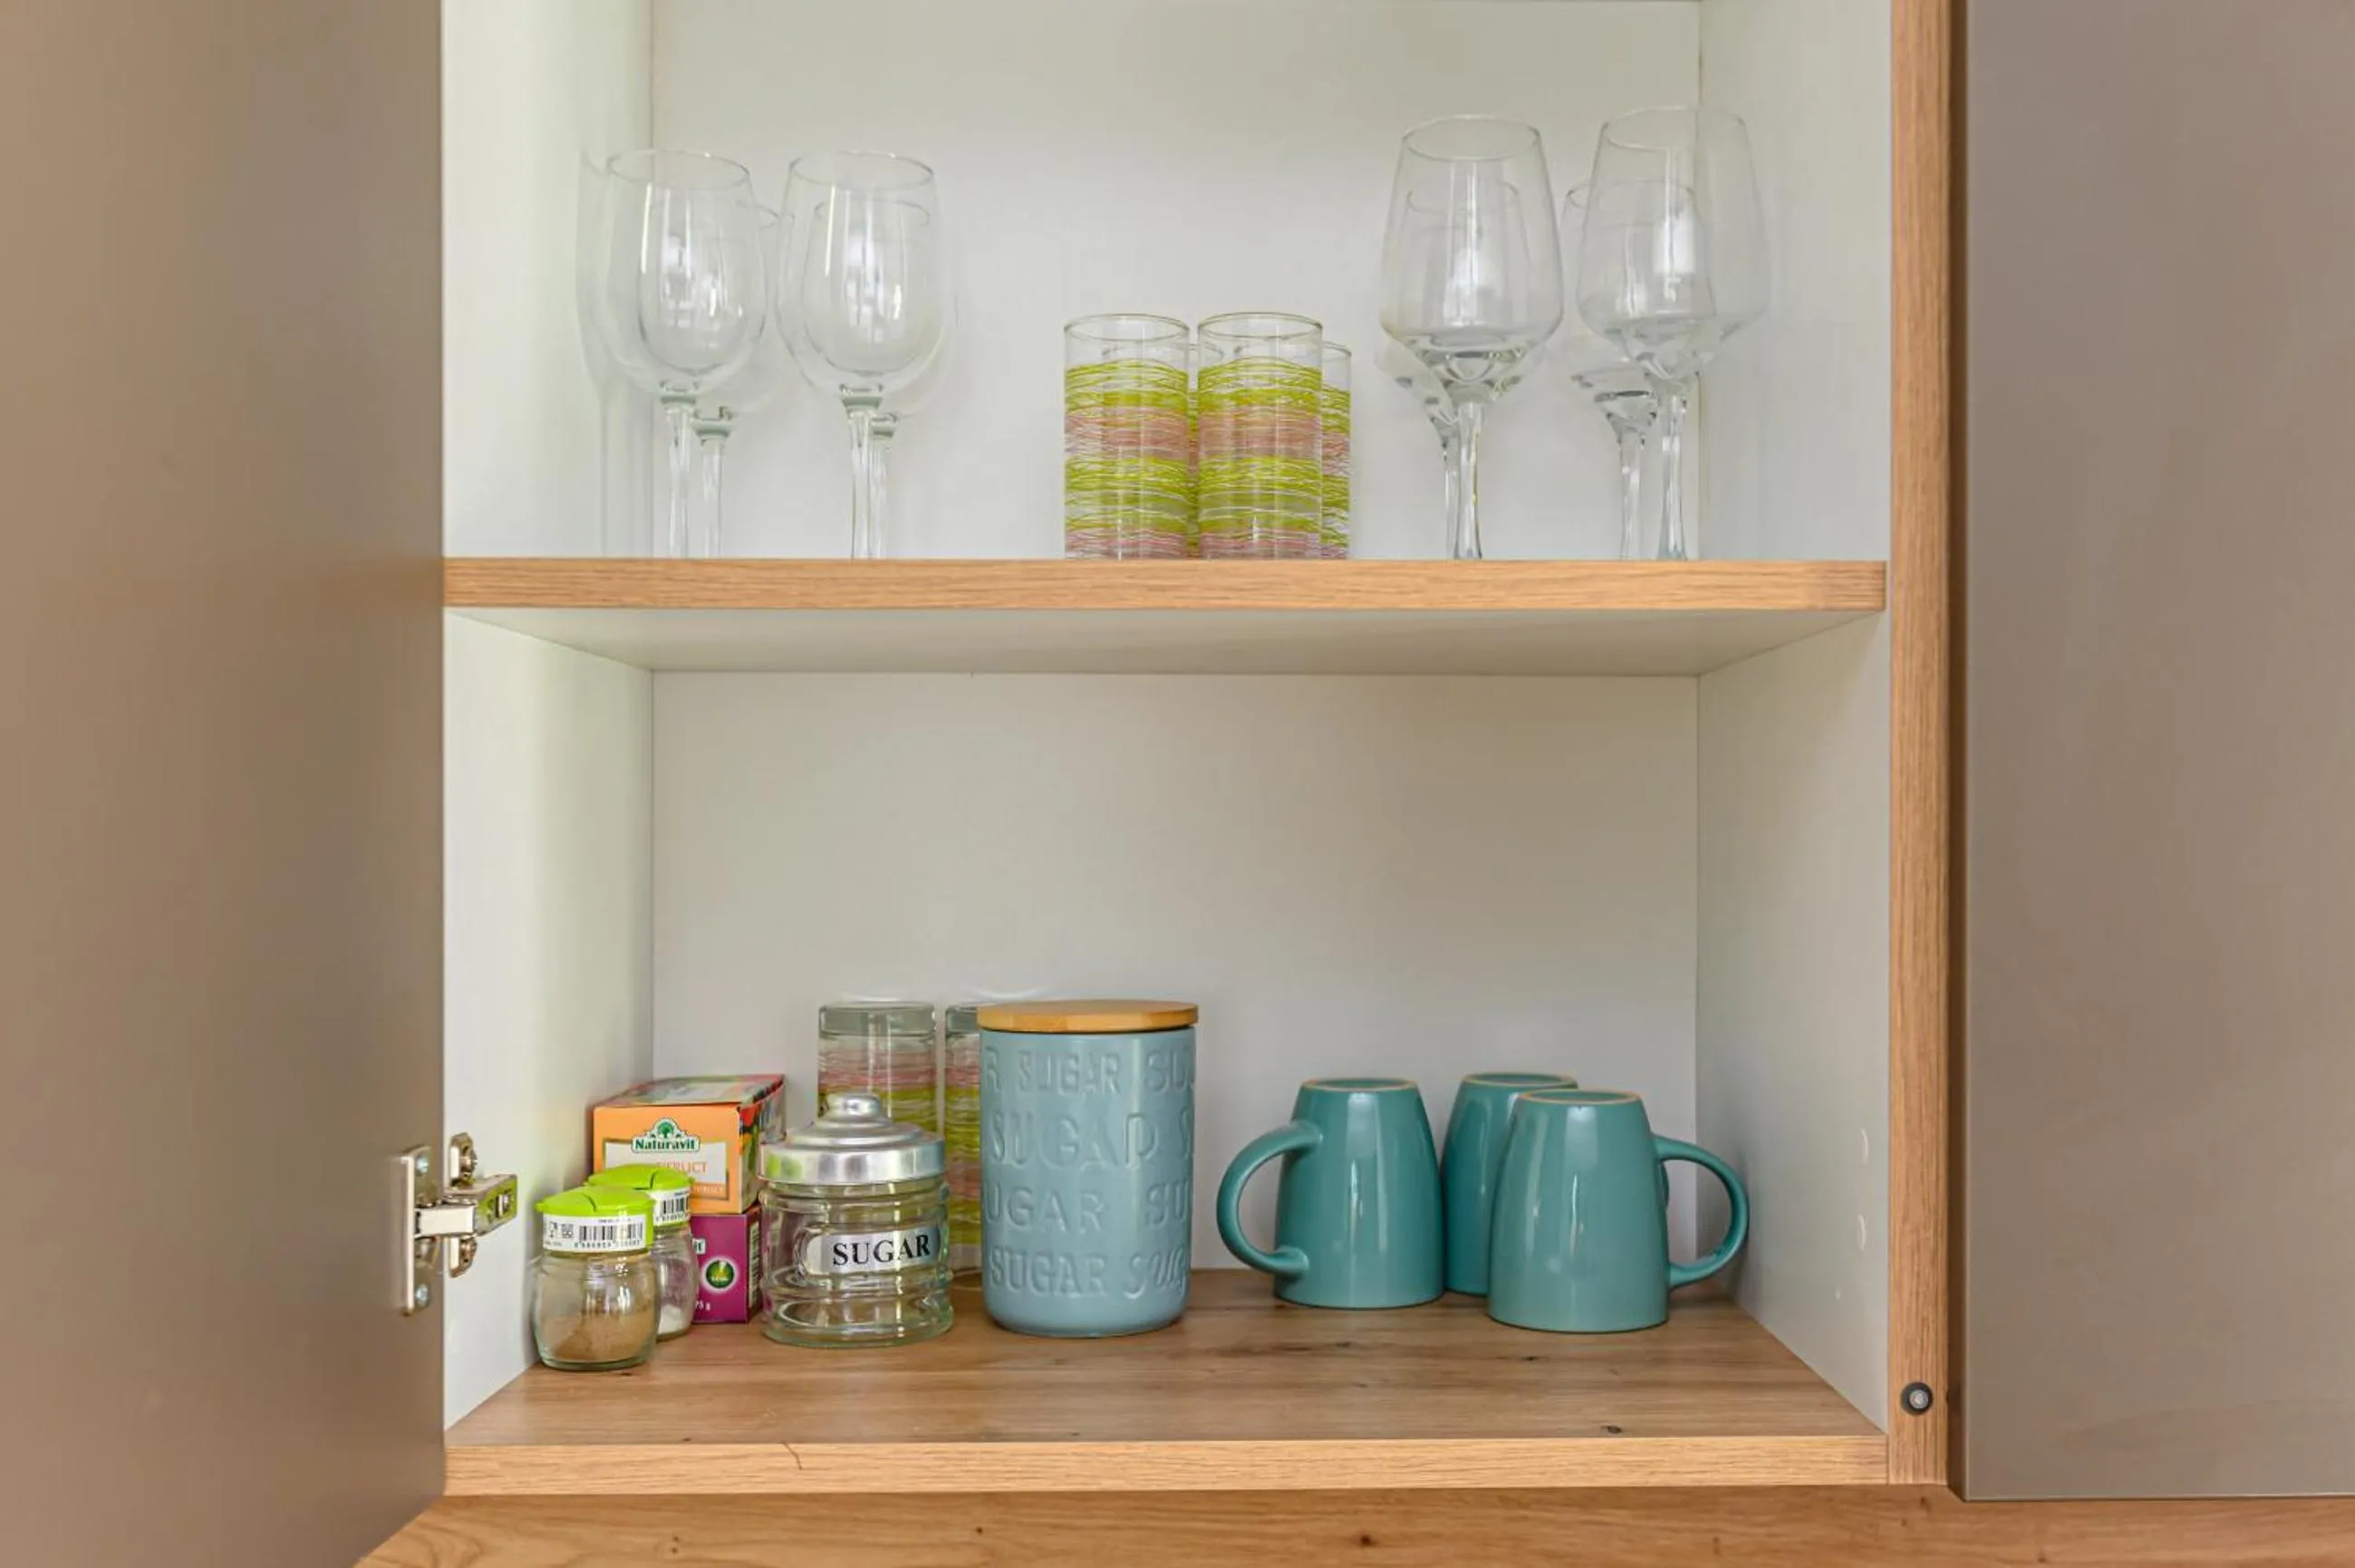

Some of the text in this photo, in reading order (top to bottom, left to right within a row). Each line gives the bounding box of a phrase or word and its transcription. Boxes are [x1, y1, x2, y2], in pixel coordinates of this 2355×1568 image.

[1017, 1048, 1122, 1095] SUGAR
[635, 1139, 695, 1150] Naturavit
[984, 1179, 1105, 1234] UGAR
[833, 1234, 931, 1266] SUGAR
[988, 1245, 1109, 1297] SUGAR
